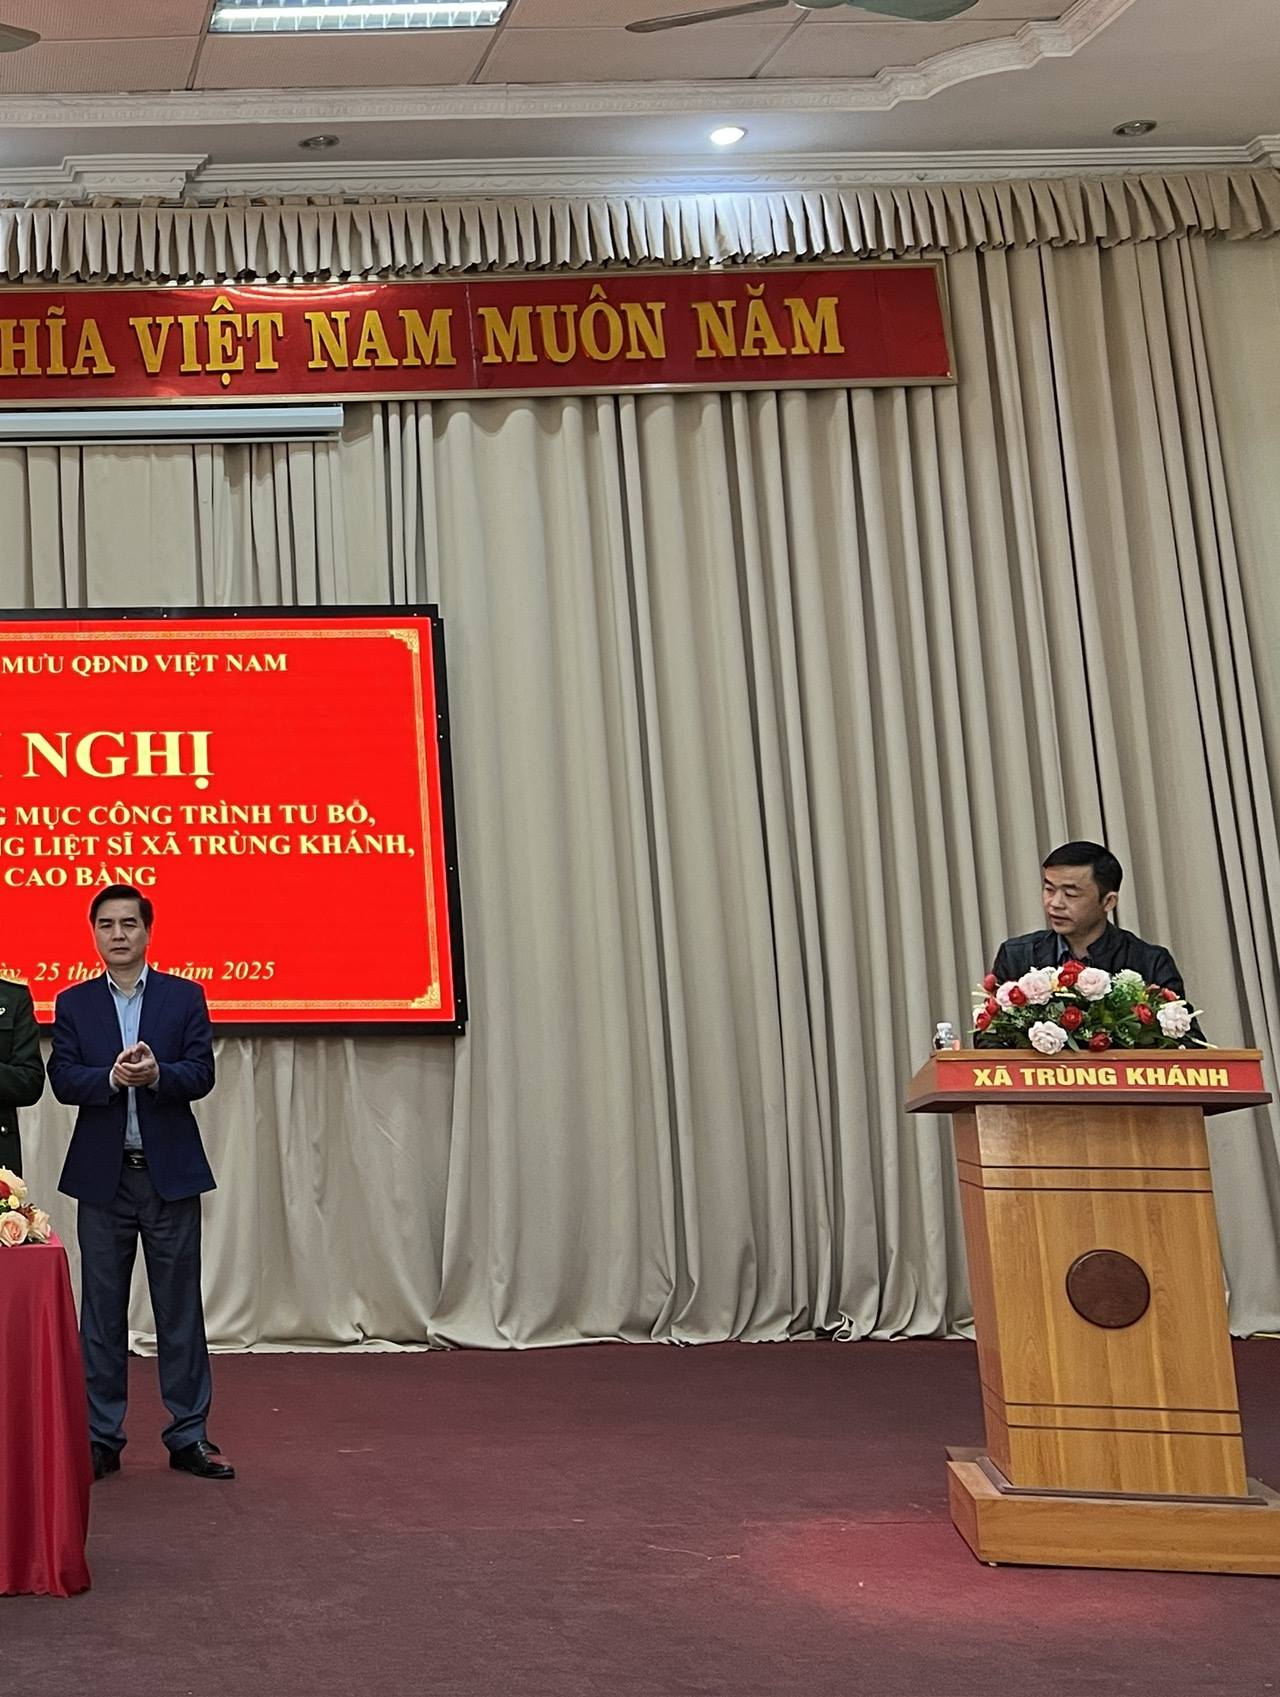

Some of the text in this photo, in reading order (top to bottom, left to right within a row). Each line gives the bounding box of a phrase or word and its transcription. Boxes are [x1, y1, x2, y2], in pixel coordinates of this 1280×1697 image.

[128, 295, 284, 387] VIỆT
[305, 310, 455, 368] NAM
[477, 284, 667, 362] MUÔN
[691, 283, 845, 358] NĂM
[2, 654, 63, 673] MƯU
[72, 655, 148, 677] QĐND
[155, 652, 218, 676] VIỆT
[226, 654, 286, 671] NAM
[22, 731, 214, 789] NGHỊ
[16, 807, 80, 830] MỤC
[89, 801, 172, 825] CÔNG
[180, 800, 271, 824] TRÌNH
[279, 805, 316, 823] TU
[34, 834, 99, 860] LIỆT
[107, 832, 133, 855] SĨ
[142, 832, 181, 855] XÃ
[189, 830, 290, 855] TRÙNG
[300, 829, 414, 857] KHÁNH,
[5, 868, 67, 886] CAO
[76, 862, 157, 887] BẰNG
[35, 963, 60, 980] 25
[67, 961, 102, 981] thá
[168, 961, 214, 981] năm
[222, 961, 274, 979] 2025
[973, 1064, 1229, 1087] XÃ TRÙNG KHÁNH
